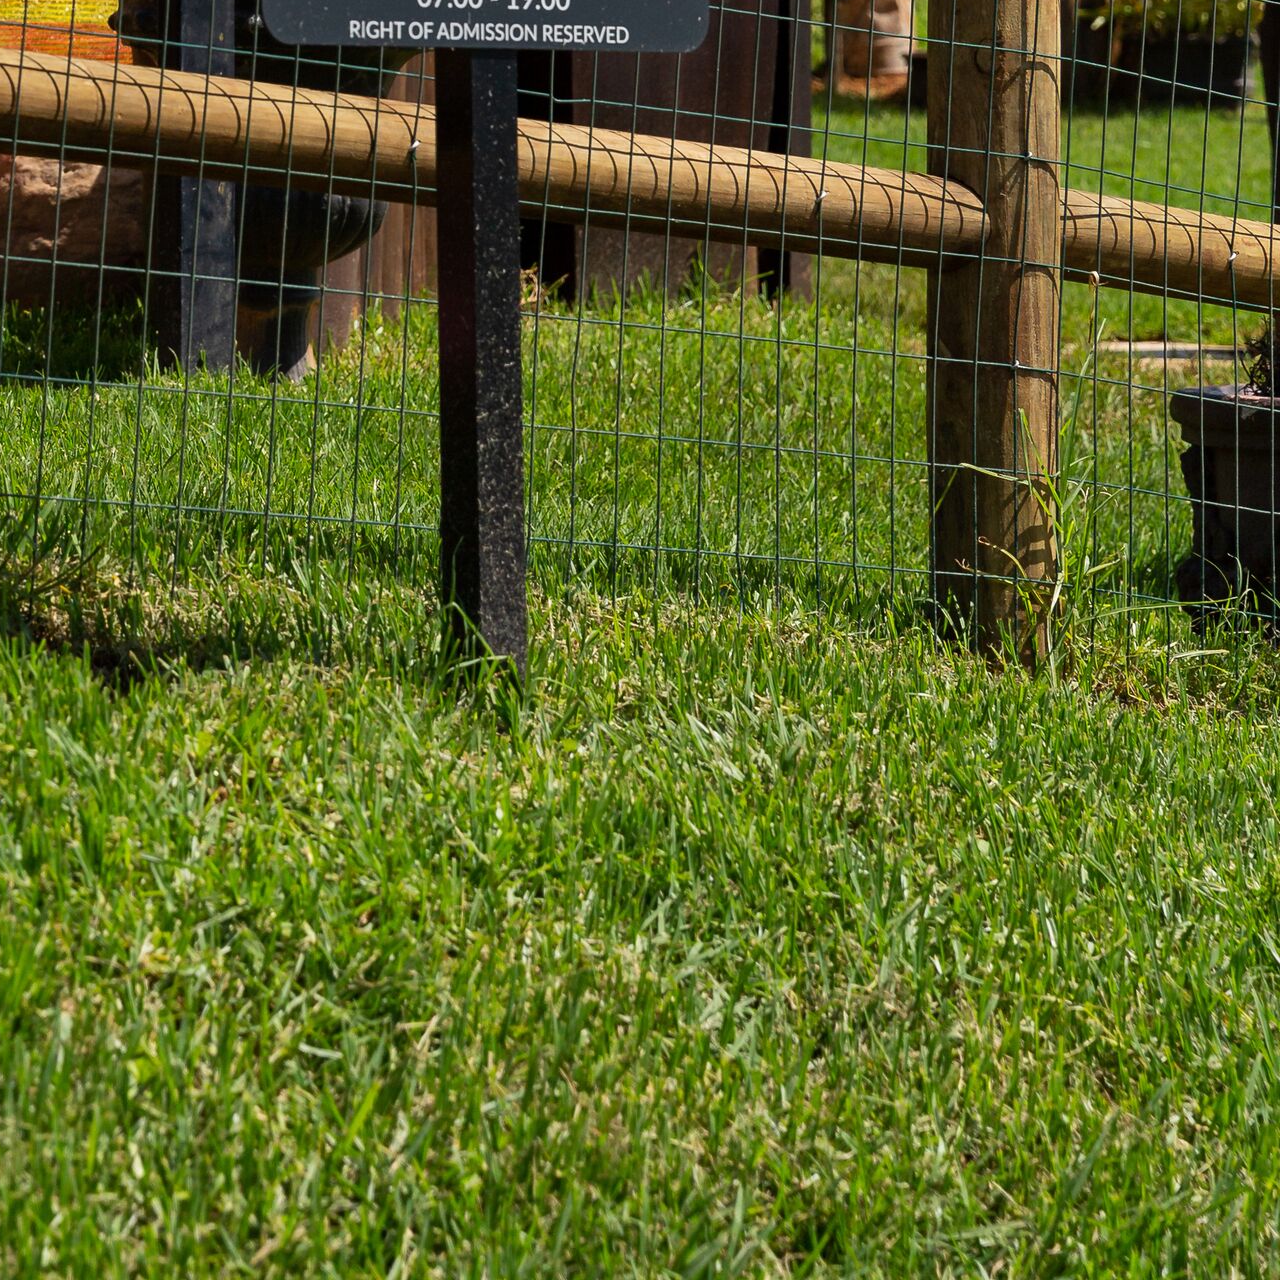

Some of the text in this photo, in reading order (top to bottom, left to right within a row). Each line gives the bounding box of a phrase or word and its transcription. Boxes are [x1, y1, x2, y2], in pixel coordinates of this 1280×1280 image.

[349, 19, 630, 45] RIGHT OF ADMISSION RESERVED
